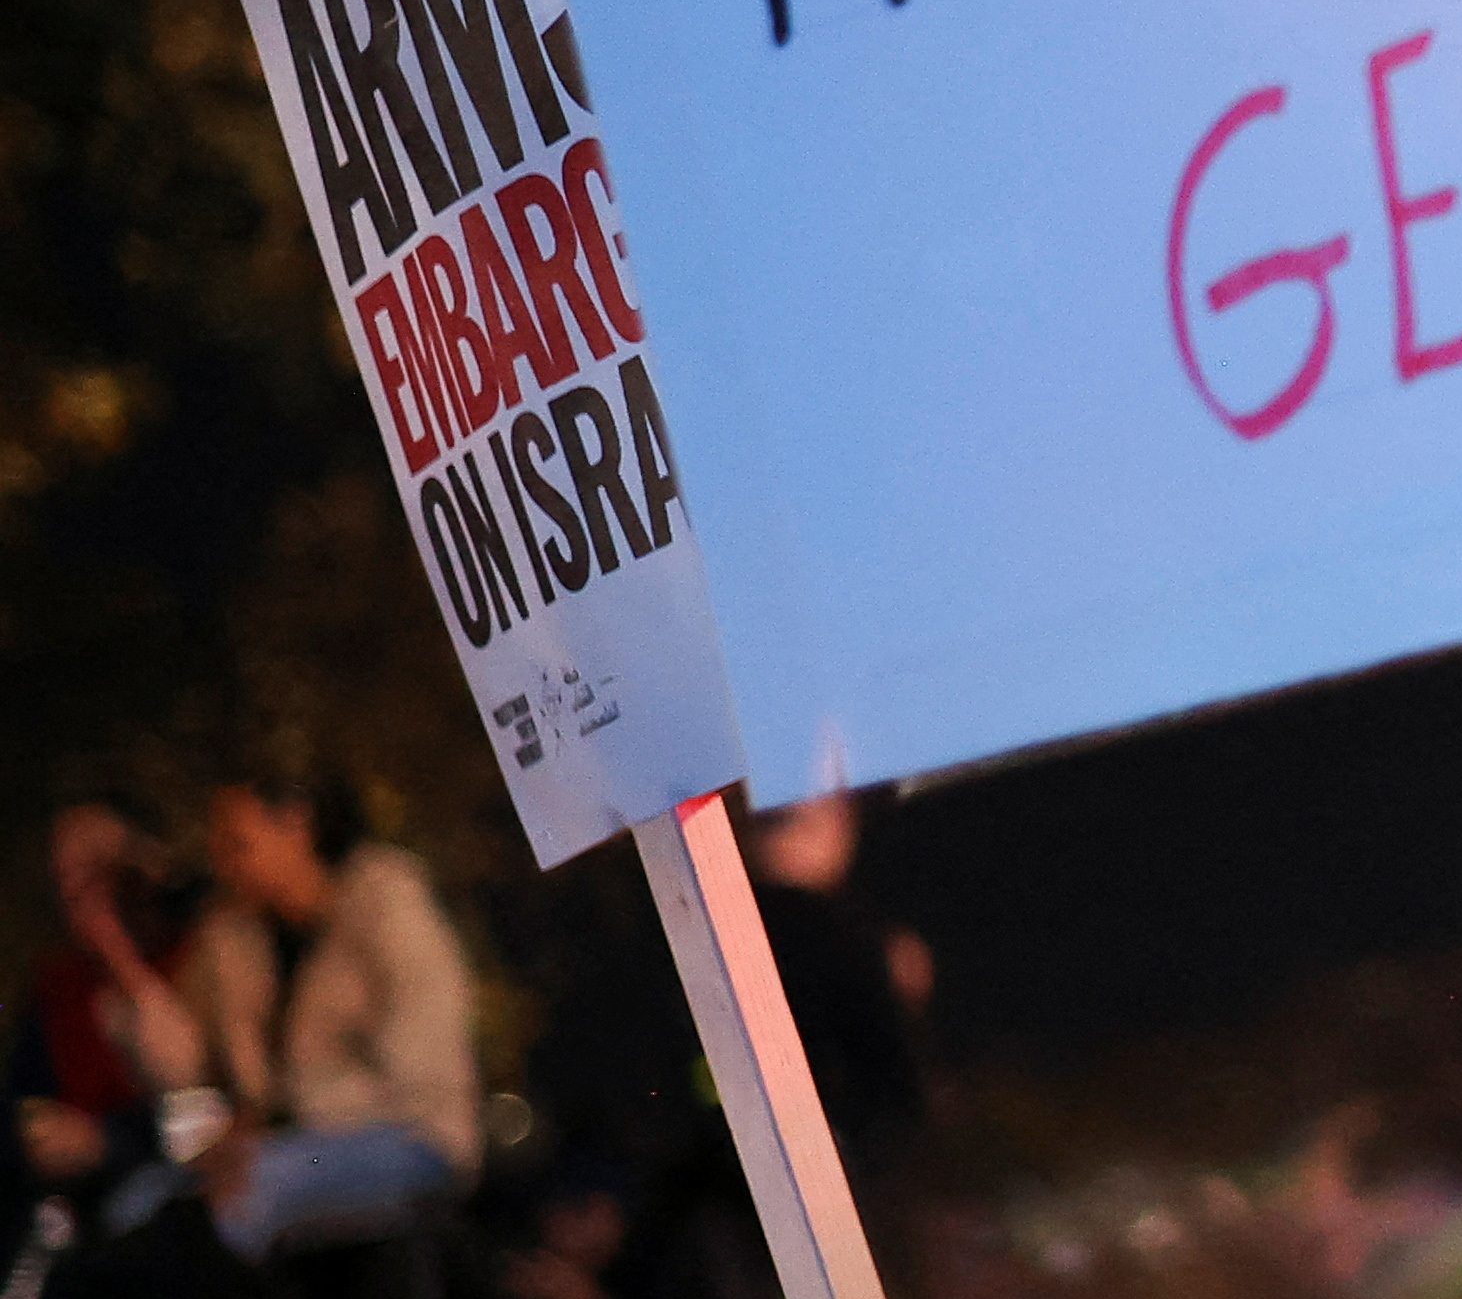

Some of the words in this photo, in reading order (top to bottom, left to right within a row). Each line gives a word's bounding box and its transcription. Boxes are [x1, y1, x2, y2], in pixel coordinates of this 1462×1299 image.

[353, 136, 645, 479] EMBARG
[418, 452, 530, 649] ON
[488, 354, 691, 606] ISRA
